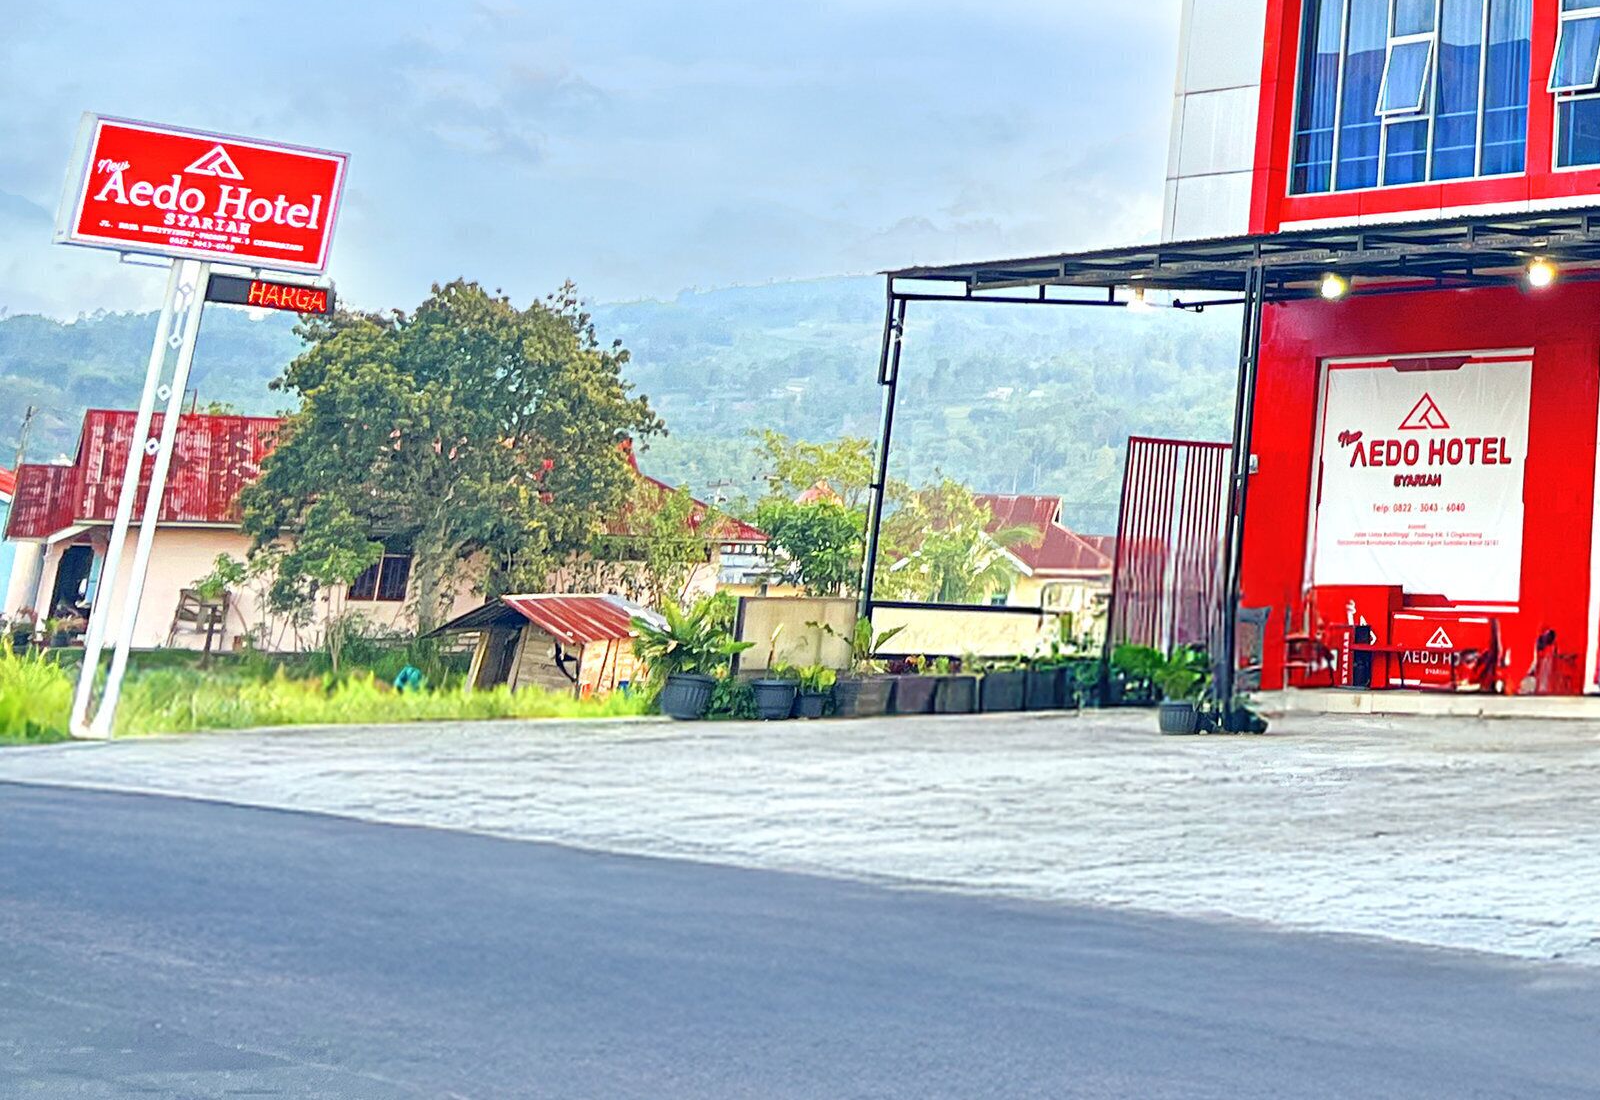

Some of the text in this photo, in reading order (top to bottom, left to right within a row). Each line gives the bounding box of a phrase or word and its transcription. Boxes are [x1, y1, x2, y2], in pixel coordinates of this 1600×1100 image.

[93, 170, 322, 229] Aedo Hotel
[163, 213, 251, 235] SYARIAH
[249, 282, 326, 311] HARGA
[1428, 437, 1512, 466] HOTEL
[1393, 503, 1412, 512] 0822
[1446, 503, 1465, 512] 6040
